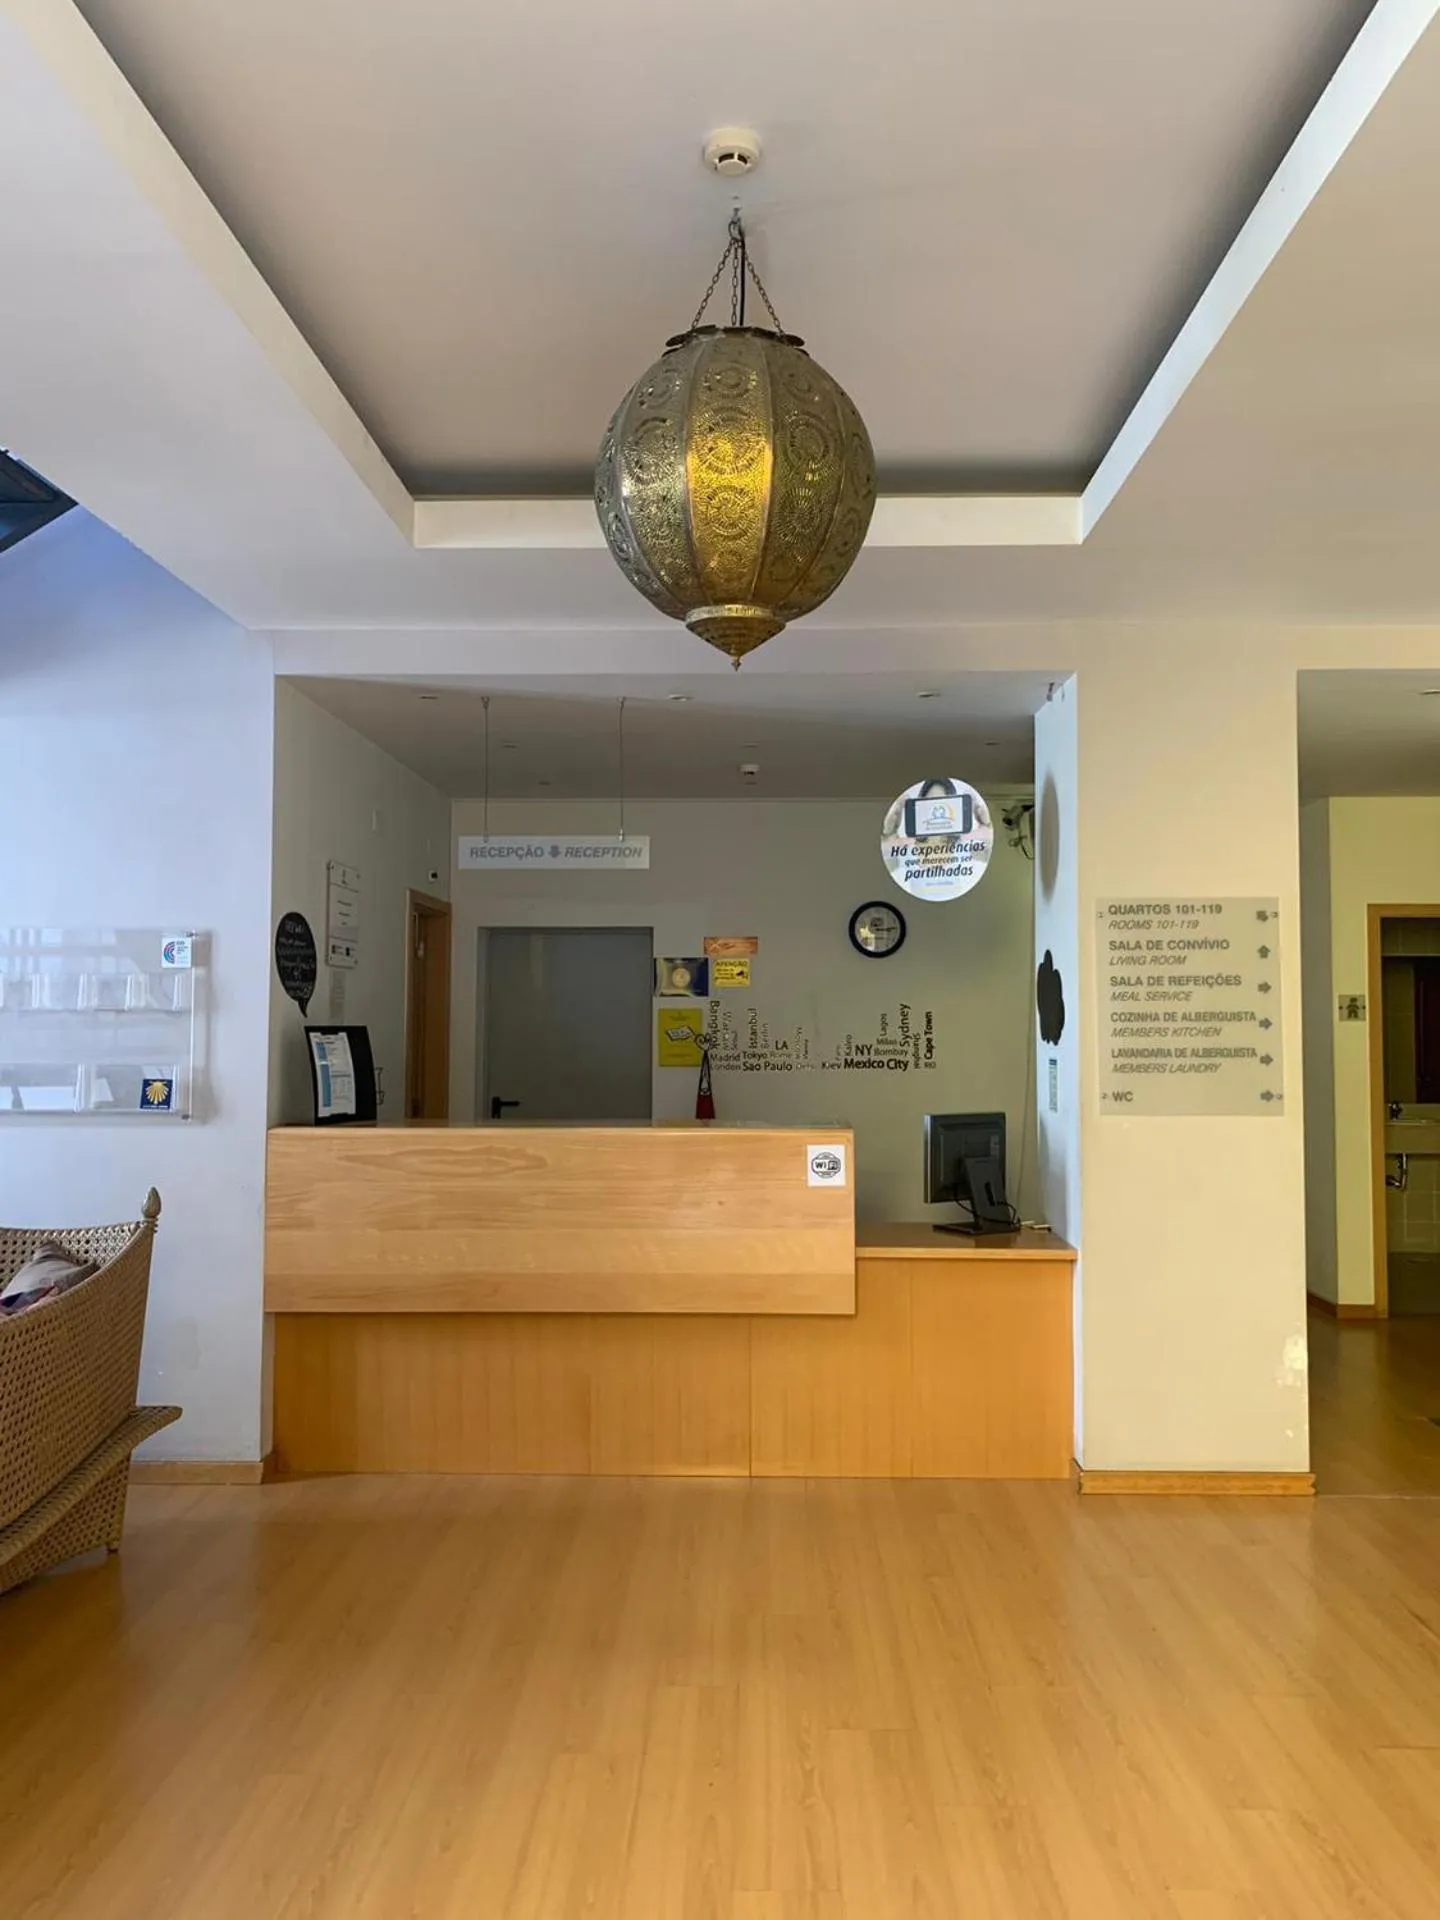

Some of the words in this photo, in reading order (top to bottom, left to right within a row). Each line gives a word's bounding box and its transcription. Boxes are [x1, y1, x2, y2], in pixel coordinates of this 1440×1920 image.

[469, 845, 545, 860] RECEPÇÃO
[564, 846, 643, 858] RECEPTION
[891, 845, 907, 857] Há
[911, 840, 986, 858] experiências
[904, 865, 973, 882] partilhadas
[1108, 903, 1171, 916] QUARTOS
[1175, 903, 1223, 915] 101-119
[1108, 919, 1153, 930] ROOMS
[1156, 919, 1200, 930] 101-119
[1109, 940, 1143, 951] SALA
[1146, 939, 1163, 951] DE
[1167, 936, 1230, 950] CONVÍVIO
[1109, 955, 1146, 966] LIVING
[1150, 955, 1187, 966] ROOM
[1110, 976, 1143, 987] SALA
[1147, 975, 1164, 987] DE
[1168, 973, 1242, 988] REFEIÇÕES
[1110, 991, 1142, 1002] MEAL
[1145, 991, 1193, 1002] SERVICE
[1110, 1012, 1159, 1023] COZINHA
[1163, 1012, 1178, 1022] DE
[1181, 1011, 1256, 1022] ALBERGUISTA
[748, 1008, 758, 1049] Istanbul
[880, 1013, 888, 1037] Lagos
[899, 1003, 912, 1048] Sydney
[924, 1011, 933, 1036] Town
[1110, 1027, 1169, 1037] MEMBERS
[1171, 1027, 1223, 1037] KITCHEN
[775, 1040, 789, 1051] LA
[855, 1044, 873, 1056] NY
[924, 1038, 935, 1060] Cape
[743, 1051, 768, 1061] Tokyo
[874, 1047, 908, 1057] Bombay
[1112, 1048, 1173, 1058] LAVANDARIA
[1175, 1048, 1188, 1058] DE
[1190, 1048, 1257, 1058] ALBERGUISTA
[764, 1060, 792, 1071] Paulo
[844, 1057, 884, 1070] Mexico
[887, 1058, 909, 1072] City
[1112, 1063, 1167, 1073] MEMBERS
[1169, 1063, 1222, 1073] LAUNDRY
[1112, 1092, 1133, 1102] WC
